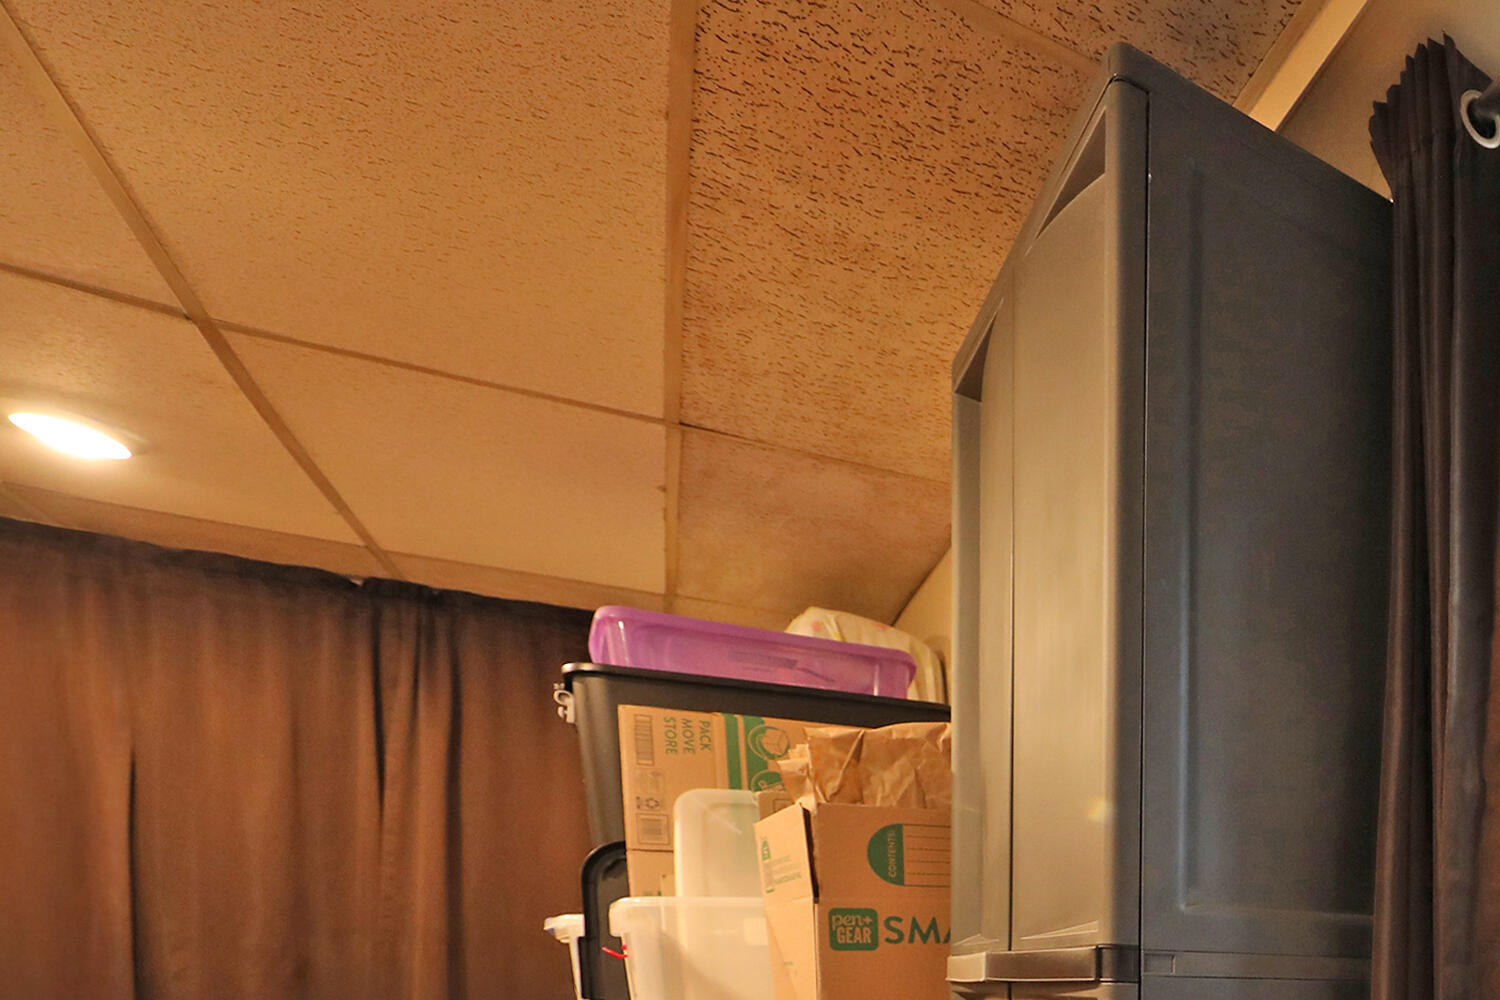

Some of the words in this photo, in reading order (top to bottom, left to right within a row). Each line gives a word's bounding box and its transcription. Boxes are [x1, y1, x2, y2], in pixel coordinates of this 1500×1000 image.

[663, 716, 679, 755] STORE
[681, 718, 696, 755] MOVE
[699, 720, 712, 751] PACK
[836, 927, 872, 944] GEAR
